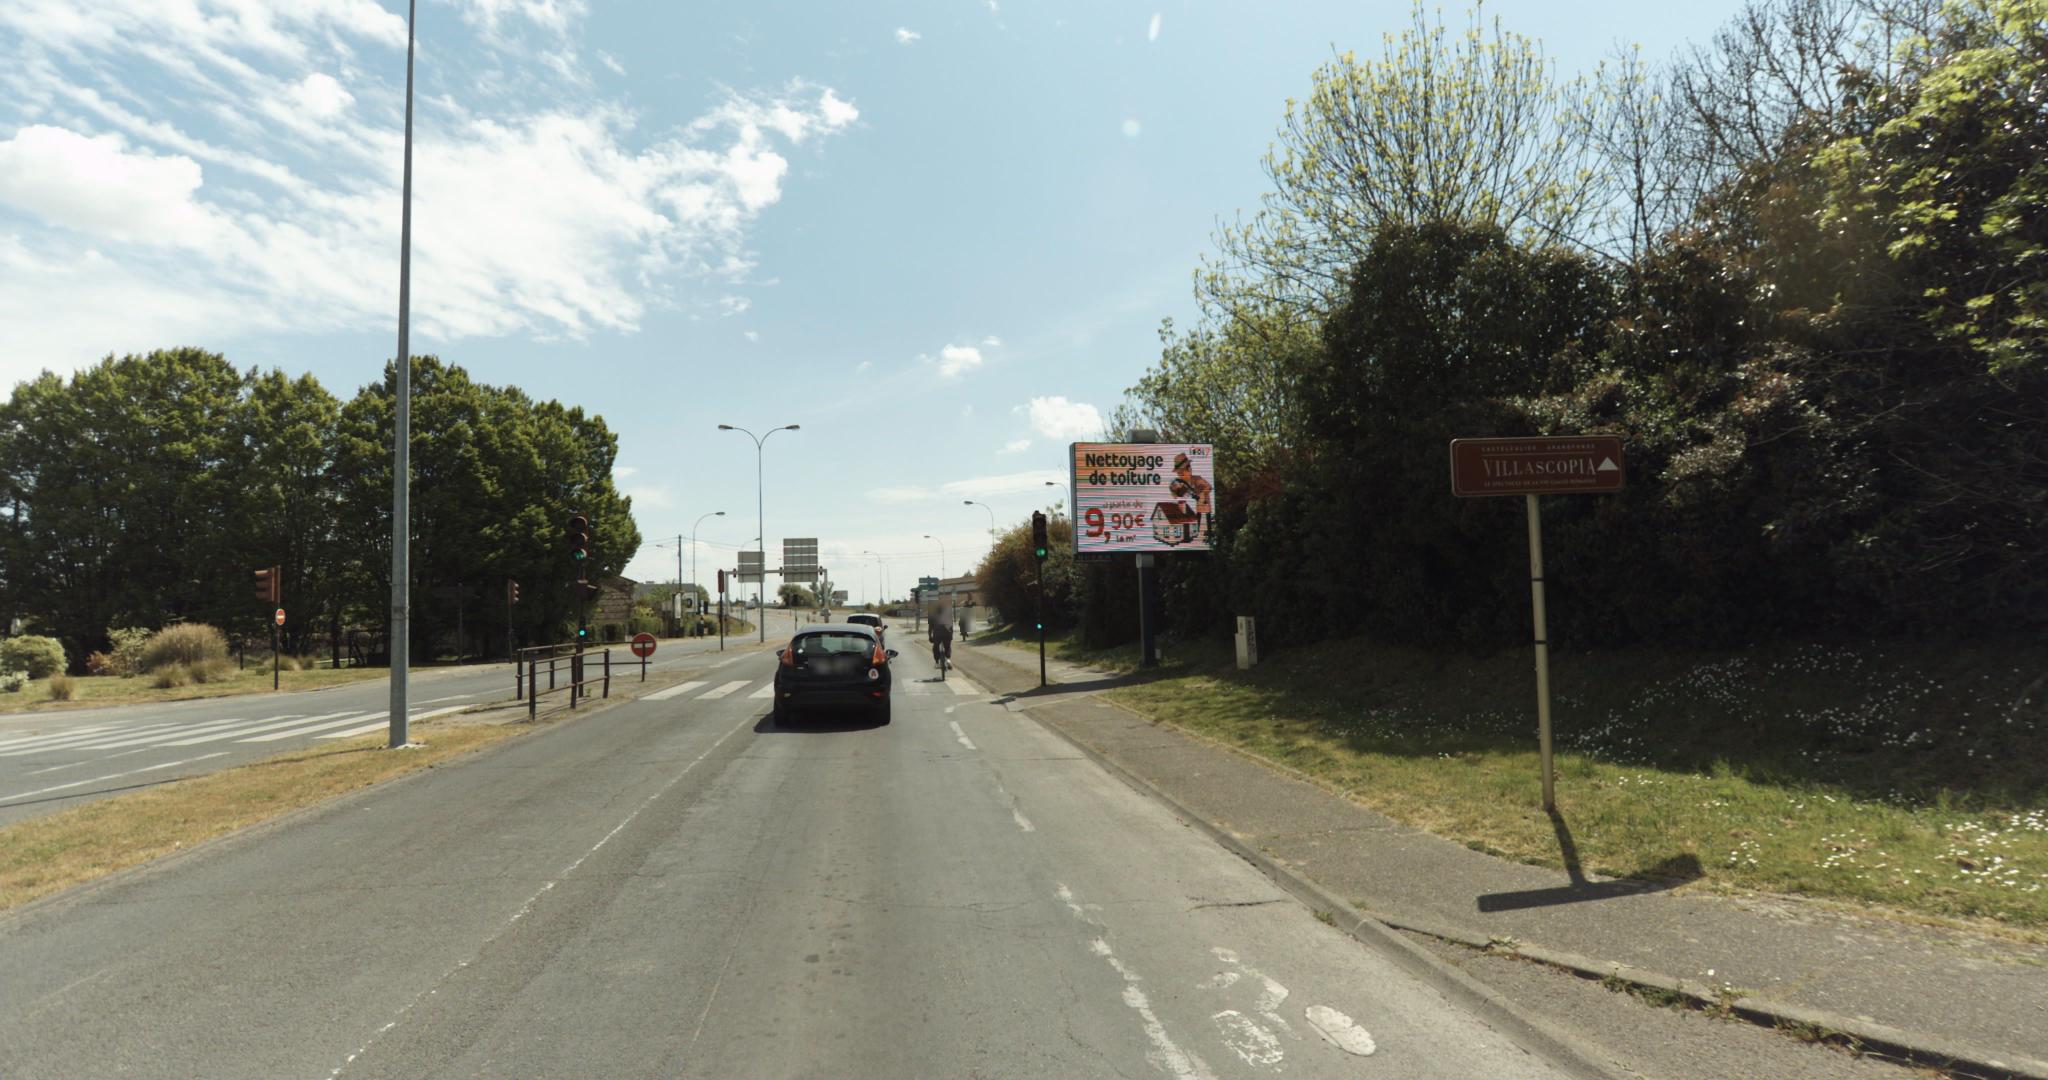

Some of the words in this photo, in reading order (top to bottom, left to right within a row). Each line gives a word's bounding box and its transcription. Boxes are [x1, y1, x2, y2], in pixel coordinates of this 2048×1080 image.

[1085, 453, 1163, 470] Nettoyage
[1482, 457, 1596, 477] VILLASCOPIA
[1089, 470, 1107, 485] de
[1111, 470, 1161, 485] toiture
